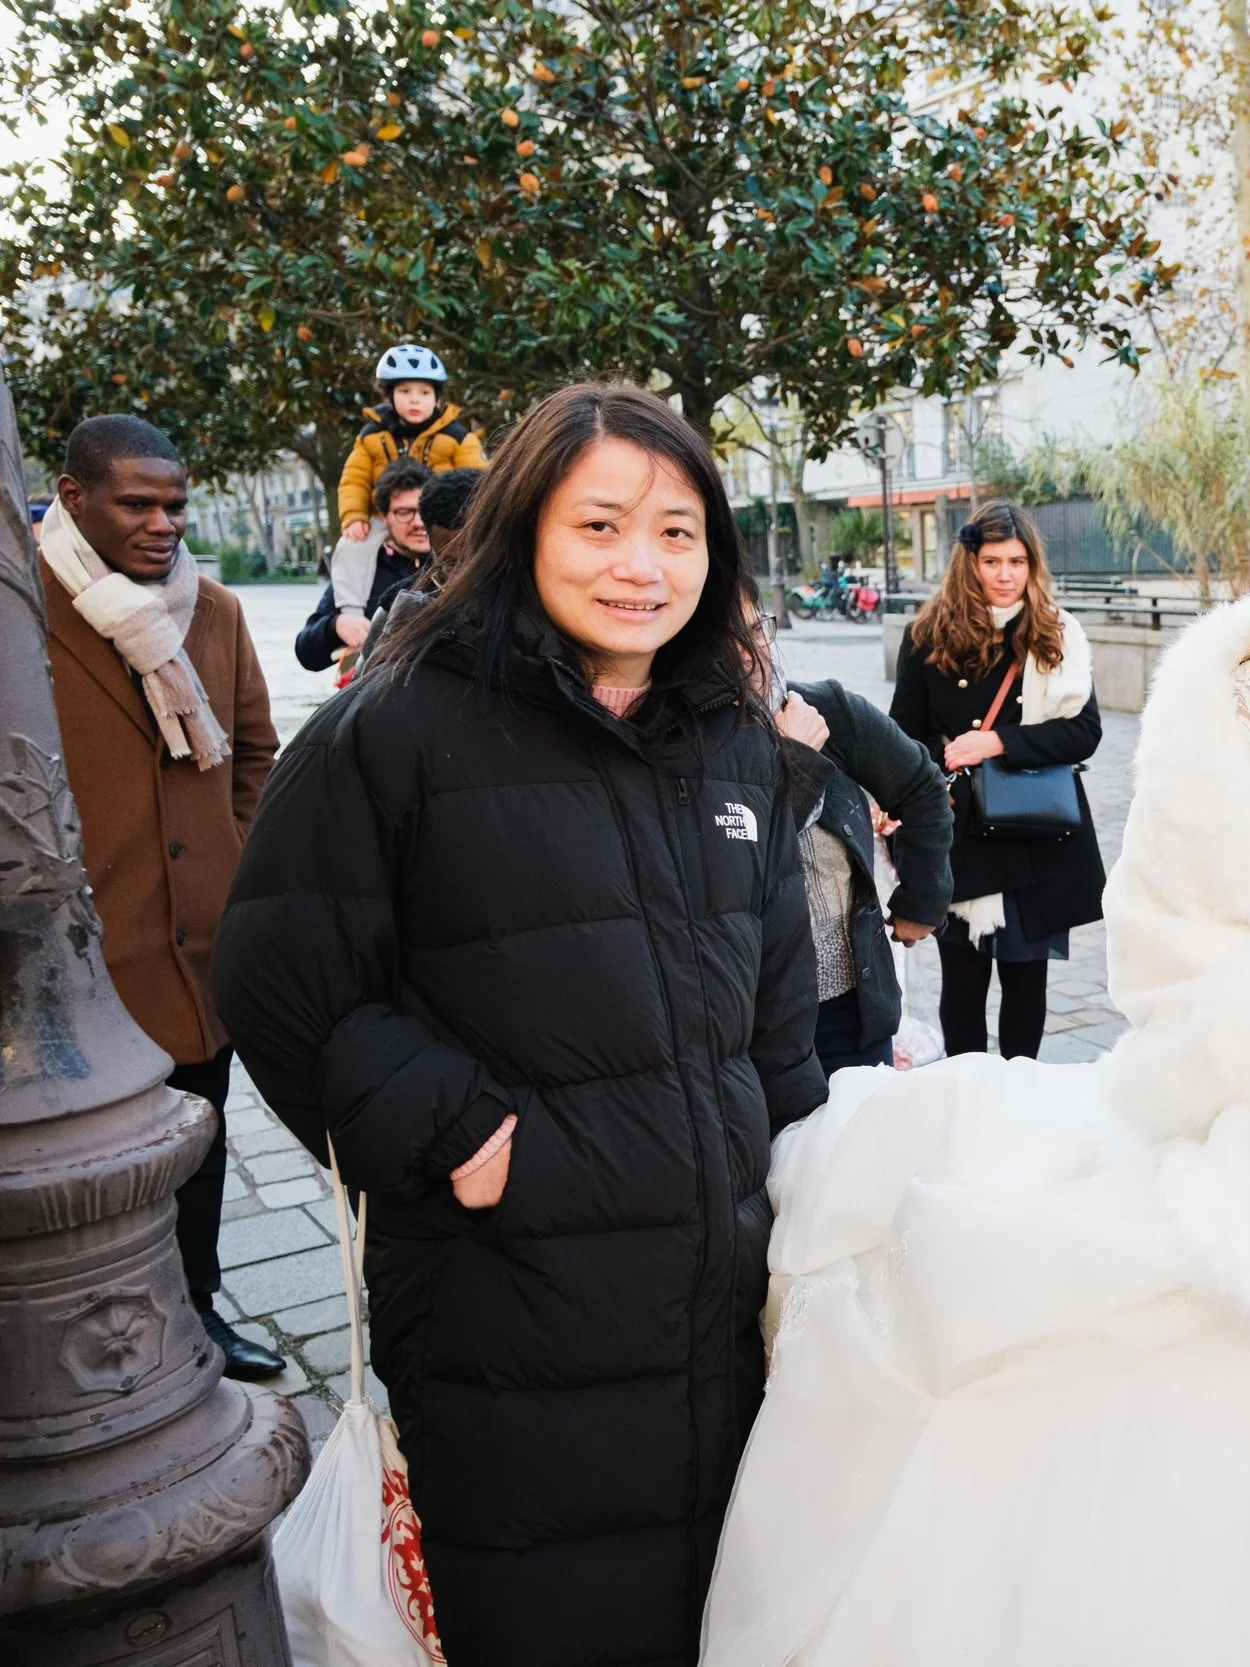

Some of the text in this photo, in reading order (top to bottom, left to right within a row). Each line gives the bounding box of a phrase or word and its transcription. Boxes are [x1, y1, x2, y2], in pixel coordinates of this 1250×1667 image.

[724, 803, 744, 814] THE
[715, 815, 747, 828] NORTH
[725, 828, 749, 840] FACE
